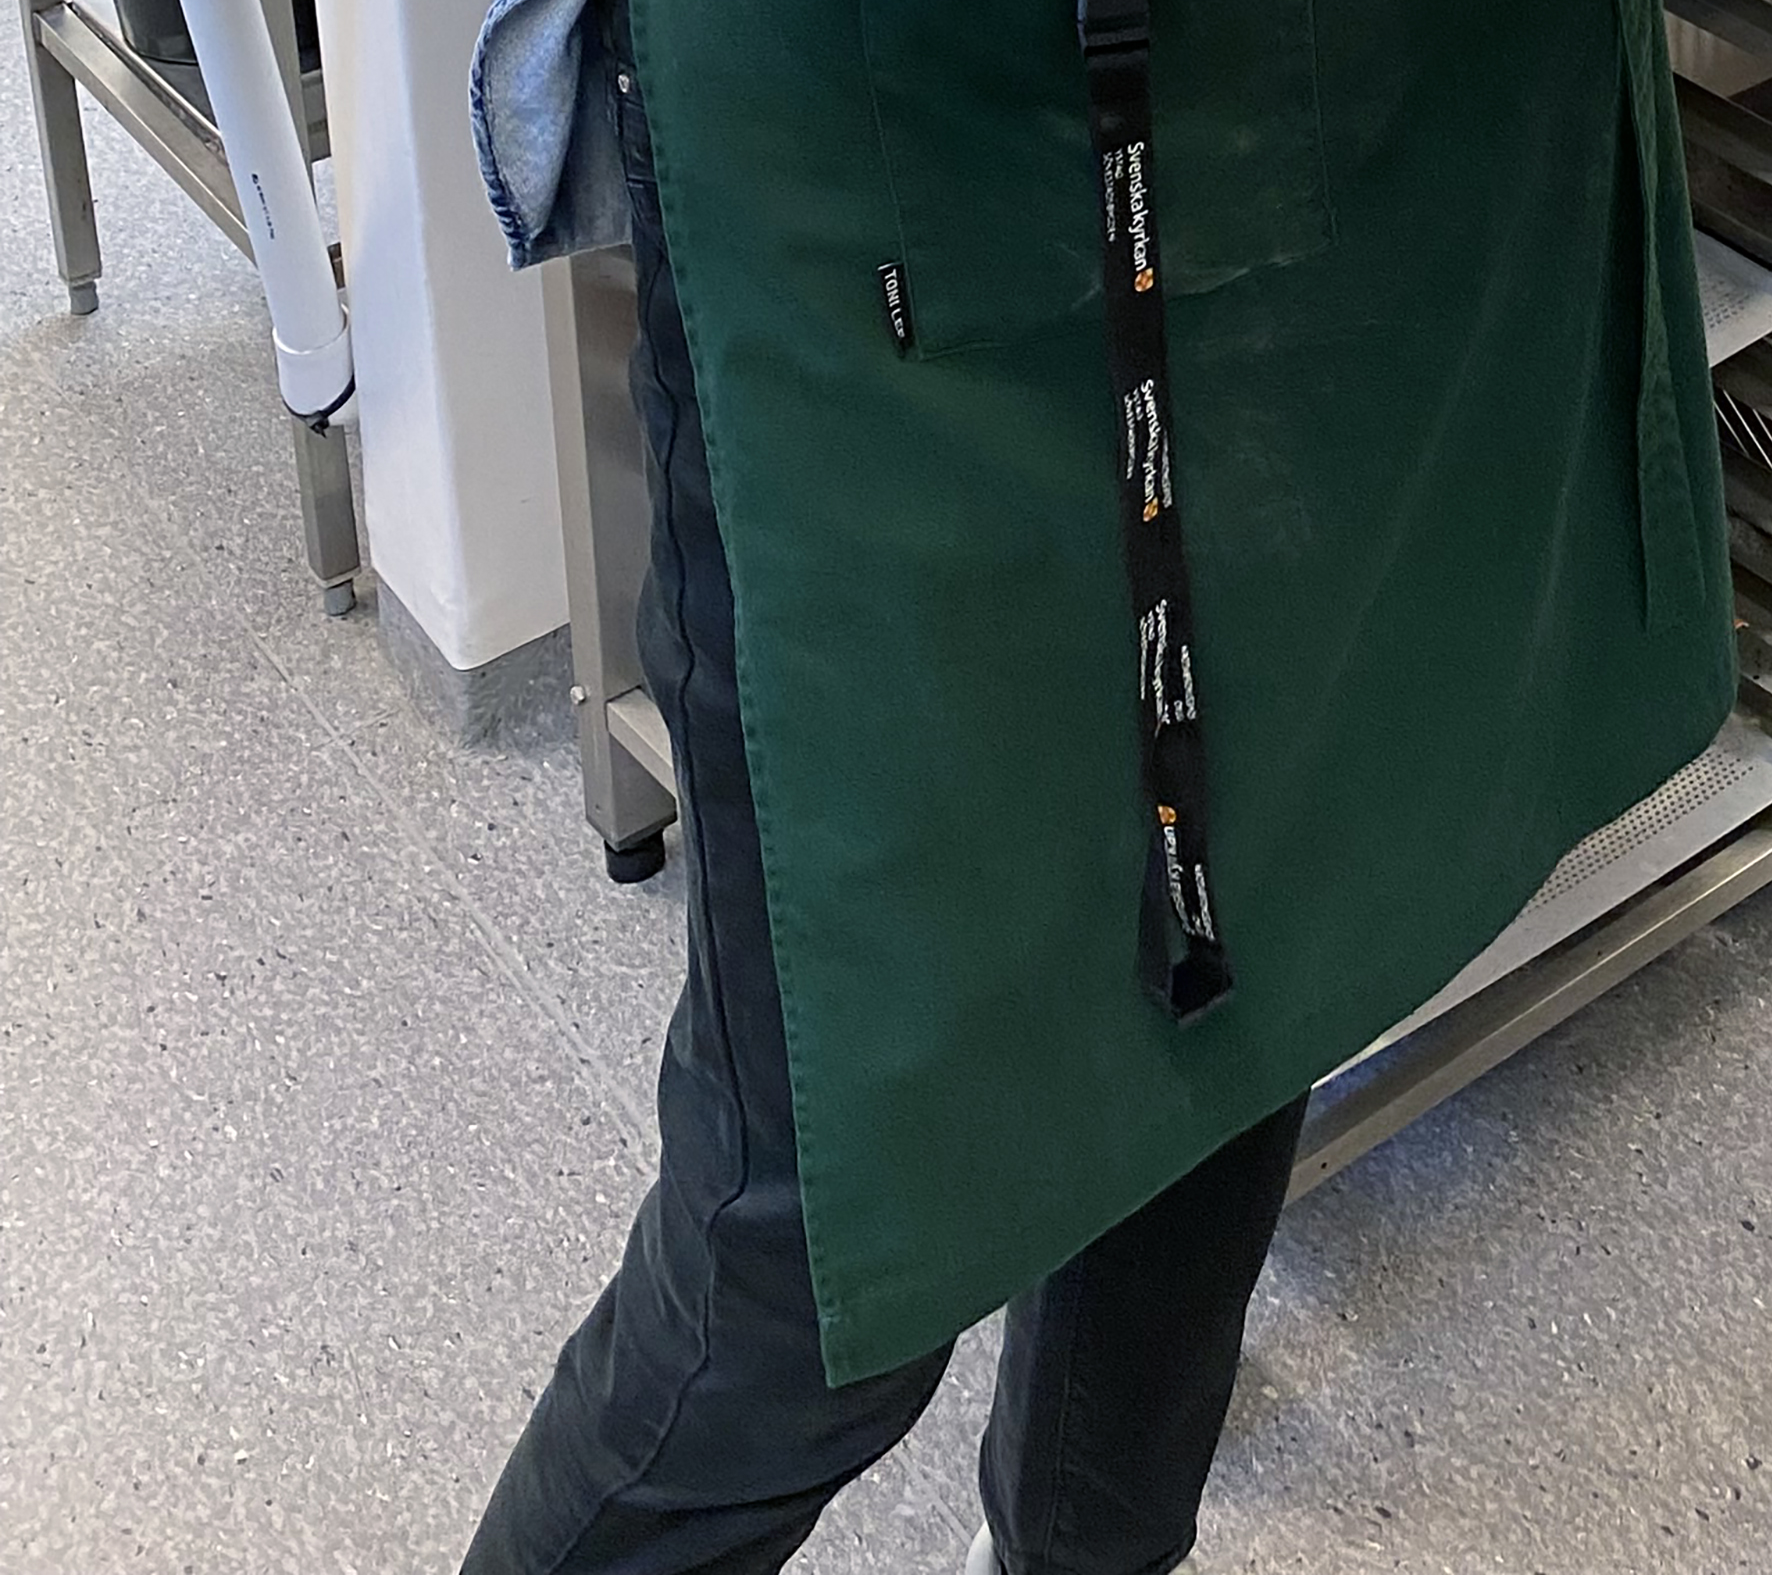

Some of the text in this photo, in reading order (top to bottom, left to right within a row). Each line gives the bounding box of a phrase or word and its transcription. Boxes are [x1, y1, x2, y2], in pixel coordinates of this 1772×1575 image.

[1127, 141, 1151, 272] Svenska kyrkan
[884, 268, 900, 307] TONI
